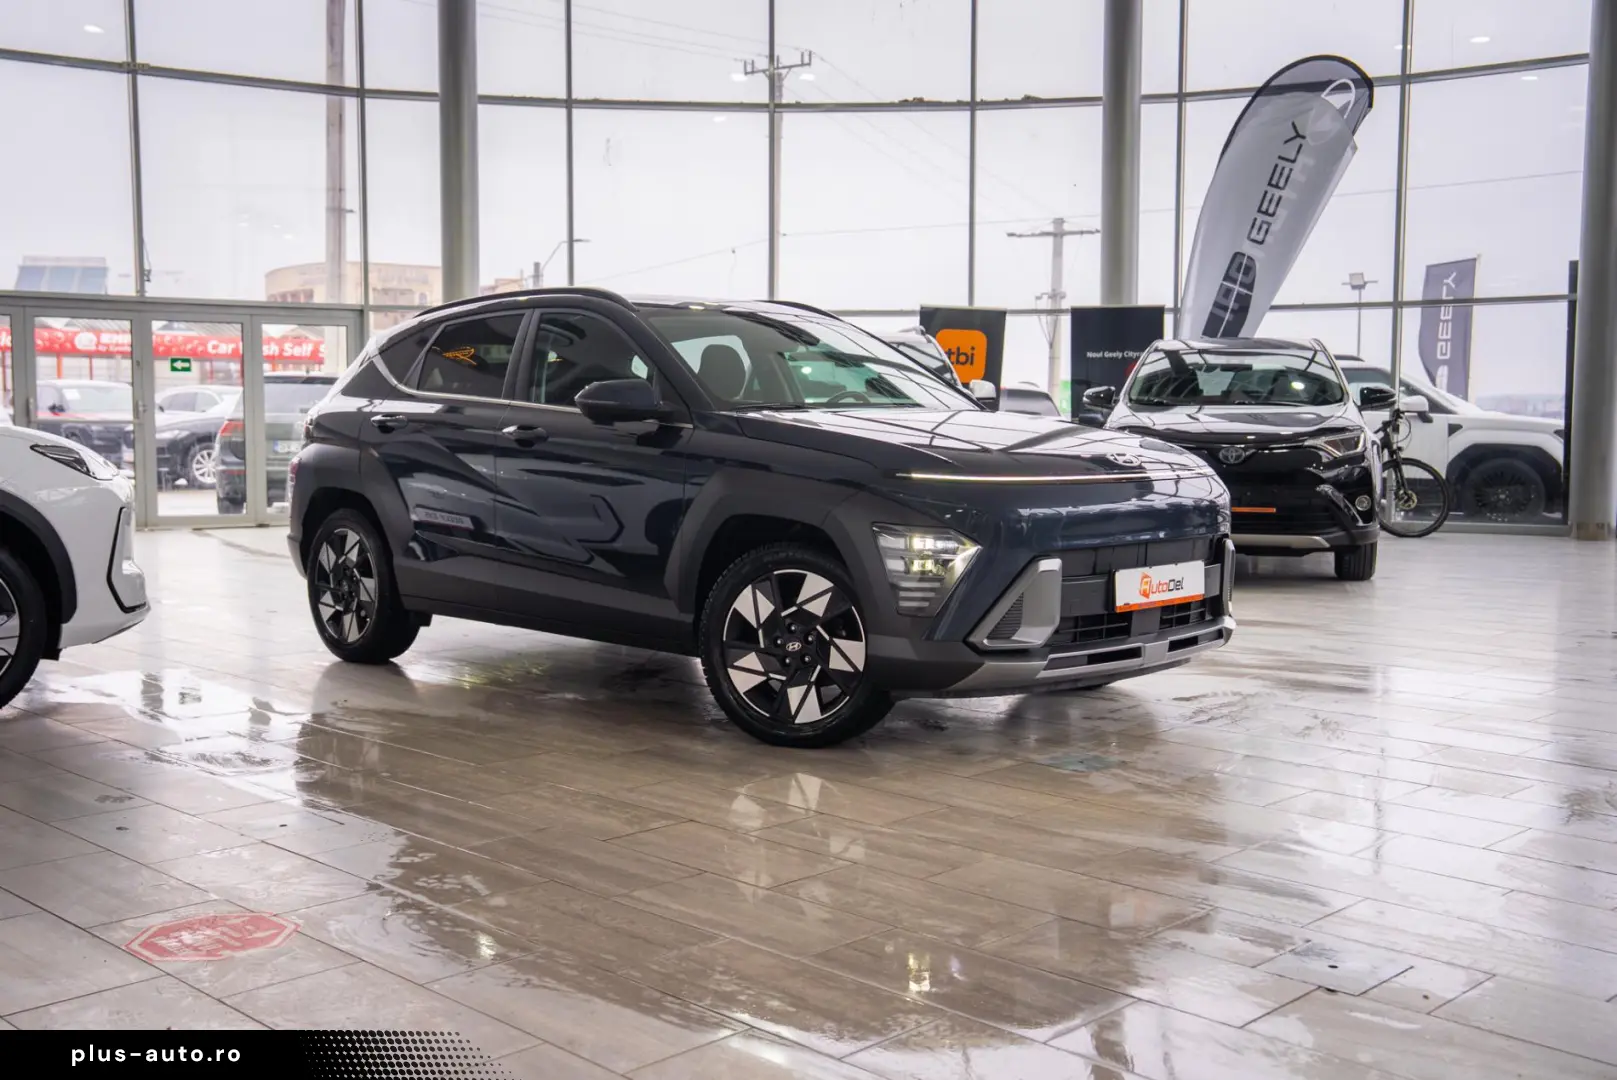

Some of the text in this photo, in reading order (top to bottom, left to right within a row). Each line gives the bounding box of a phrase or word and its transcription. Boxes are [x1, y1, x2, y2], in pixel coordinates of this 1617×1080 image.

[1247, 121, 1306, 245] GEELY
[1436, 271, 1457, 360] GEELY
[206, 340, 236, 354] Car
[282, 342, 314, 357] Self
[945, 345, 975, 366] tbi
[1104, 351, 1123, 359] Geely
[1139, 573, 1184, 598] AutoDel
